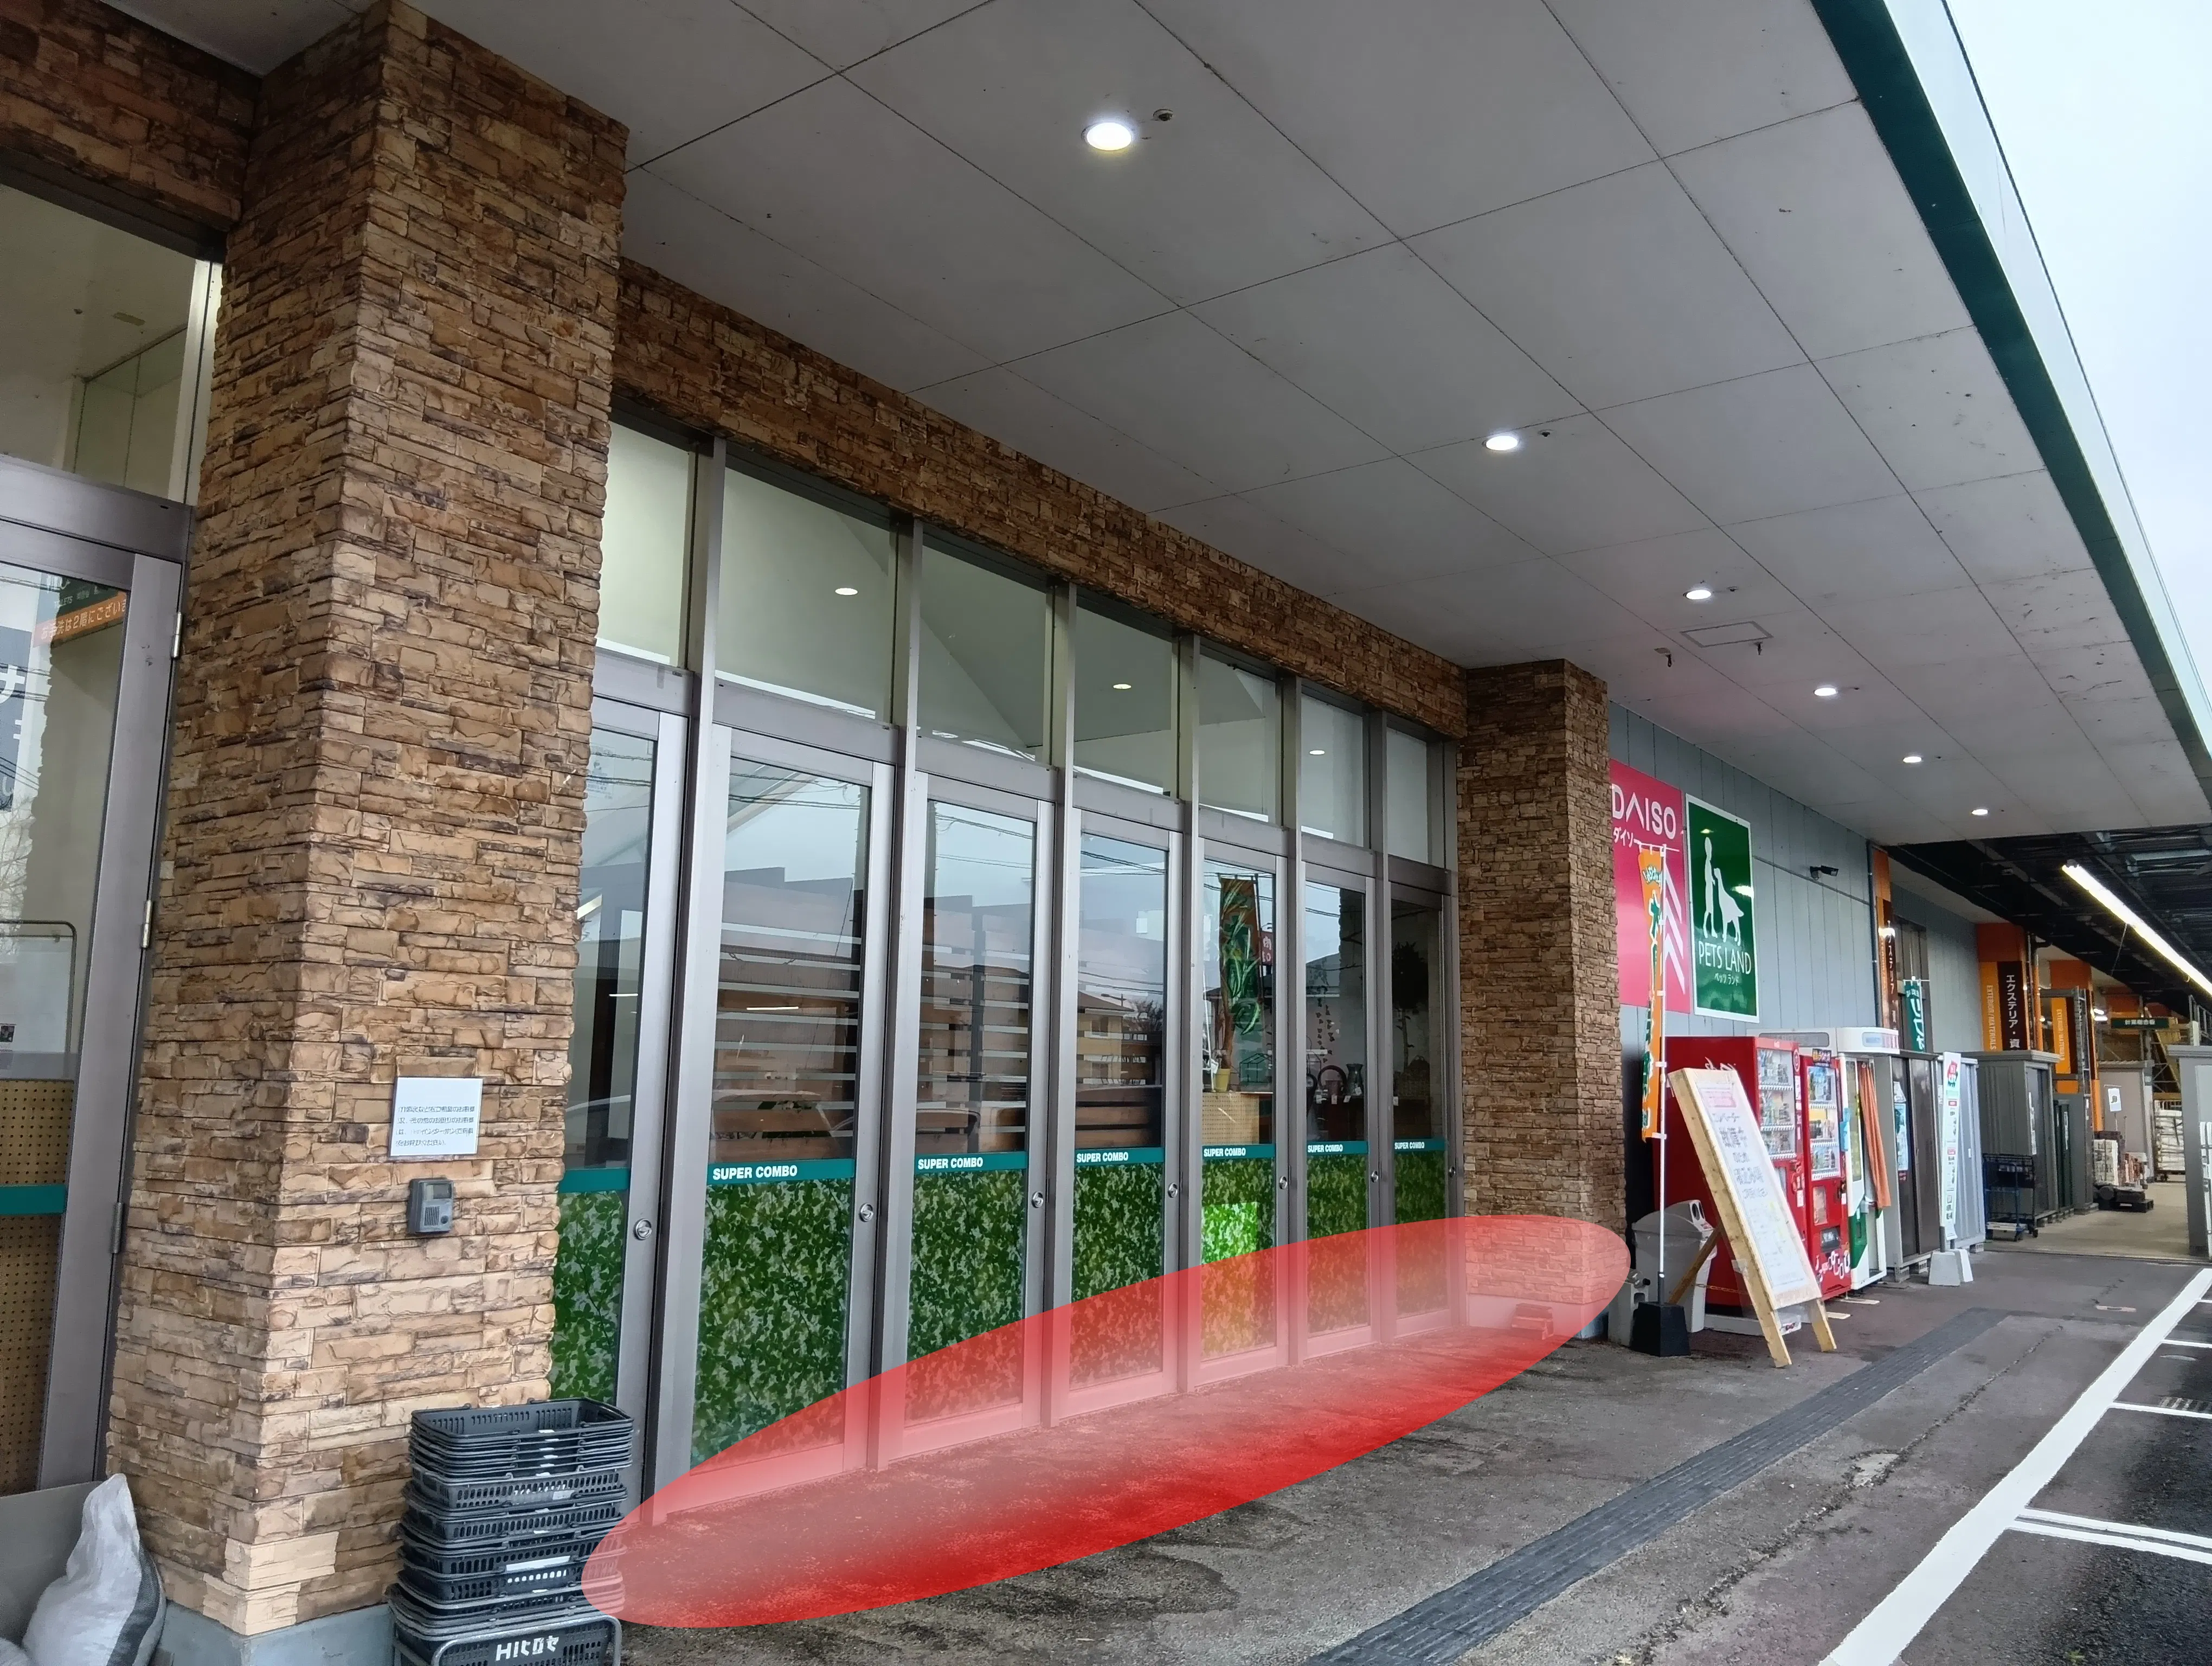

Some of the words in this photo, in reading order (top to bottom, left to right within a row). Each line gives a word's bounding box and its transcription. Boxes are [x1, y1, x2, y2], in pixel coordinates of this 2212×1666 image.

[1611, 783, 1676, 840] DAISO
[1613, 826, 1640, 848] ダイソー
[1699, 940, 1722, 969] PETS
[1725, 947, 1752, 975] LAND
[1204, 1149, 1224, 1157] SUPER
[1225, 1148, 1246, 1156] COMBO
[1308, 1145, 1324, 1153] SUPER
[1325, 1144, 1343, 1152] COMBO
[918, 1159, 949, 1170] SUPER
[950, 1157, 983, 1168] COMBO
[1077, 1153, 1101, 1163] SUPER
[1102, 1152, 1129, 1162] COMBO
[713, 1168, 753, 1180] SUPER
[755, 1165, 798, 1177] COMBO
